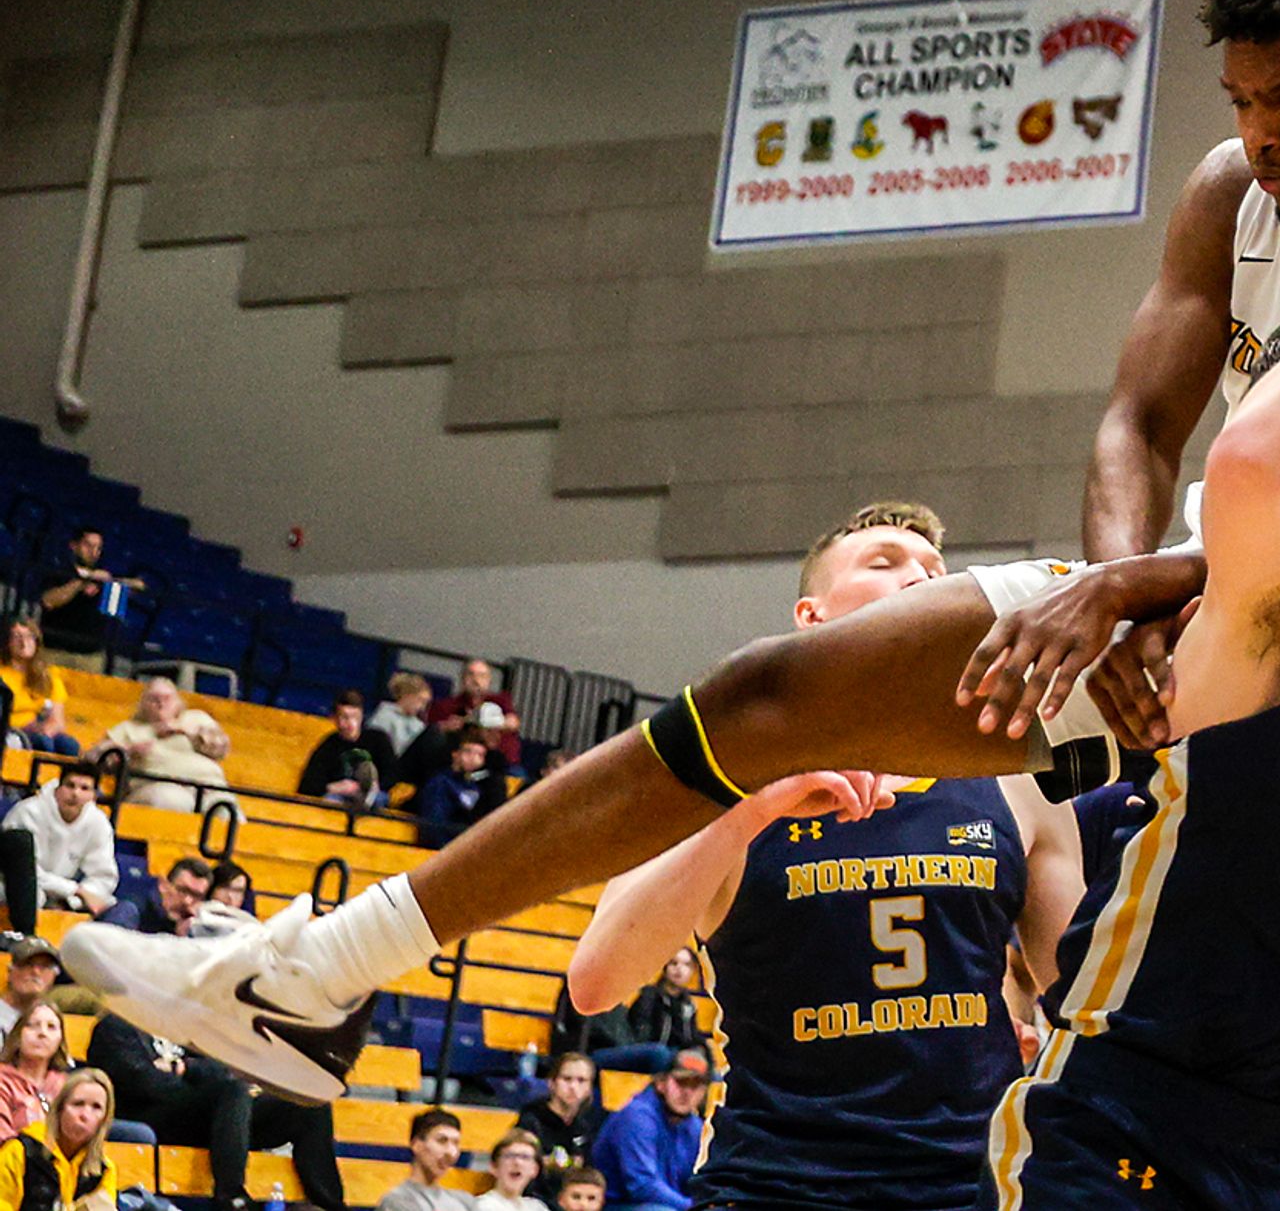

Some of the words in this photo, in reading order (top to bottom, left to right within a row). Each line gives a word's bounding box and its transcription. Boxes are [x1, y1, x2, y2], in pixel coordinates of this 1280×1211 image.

[844, 40, 901, 71] ALL
[911, 28, 1031, 65] SPORTS
[853, 61, 1016, 101] CHAMPION
[966, 822, 993, 840] SKY
[787, 854, 998, 900] NORTHERN
[868, 895, 929, 990] 5
